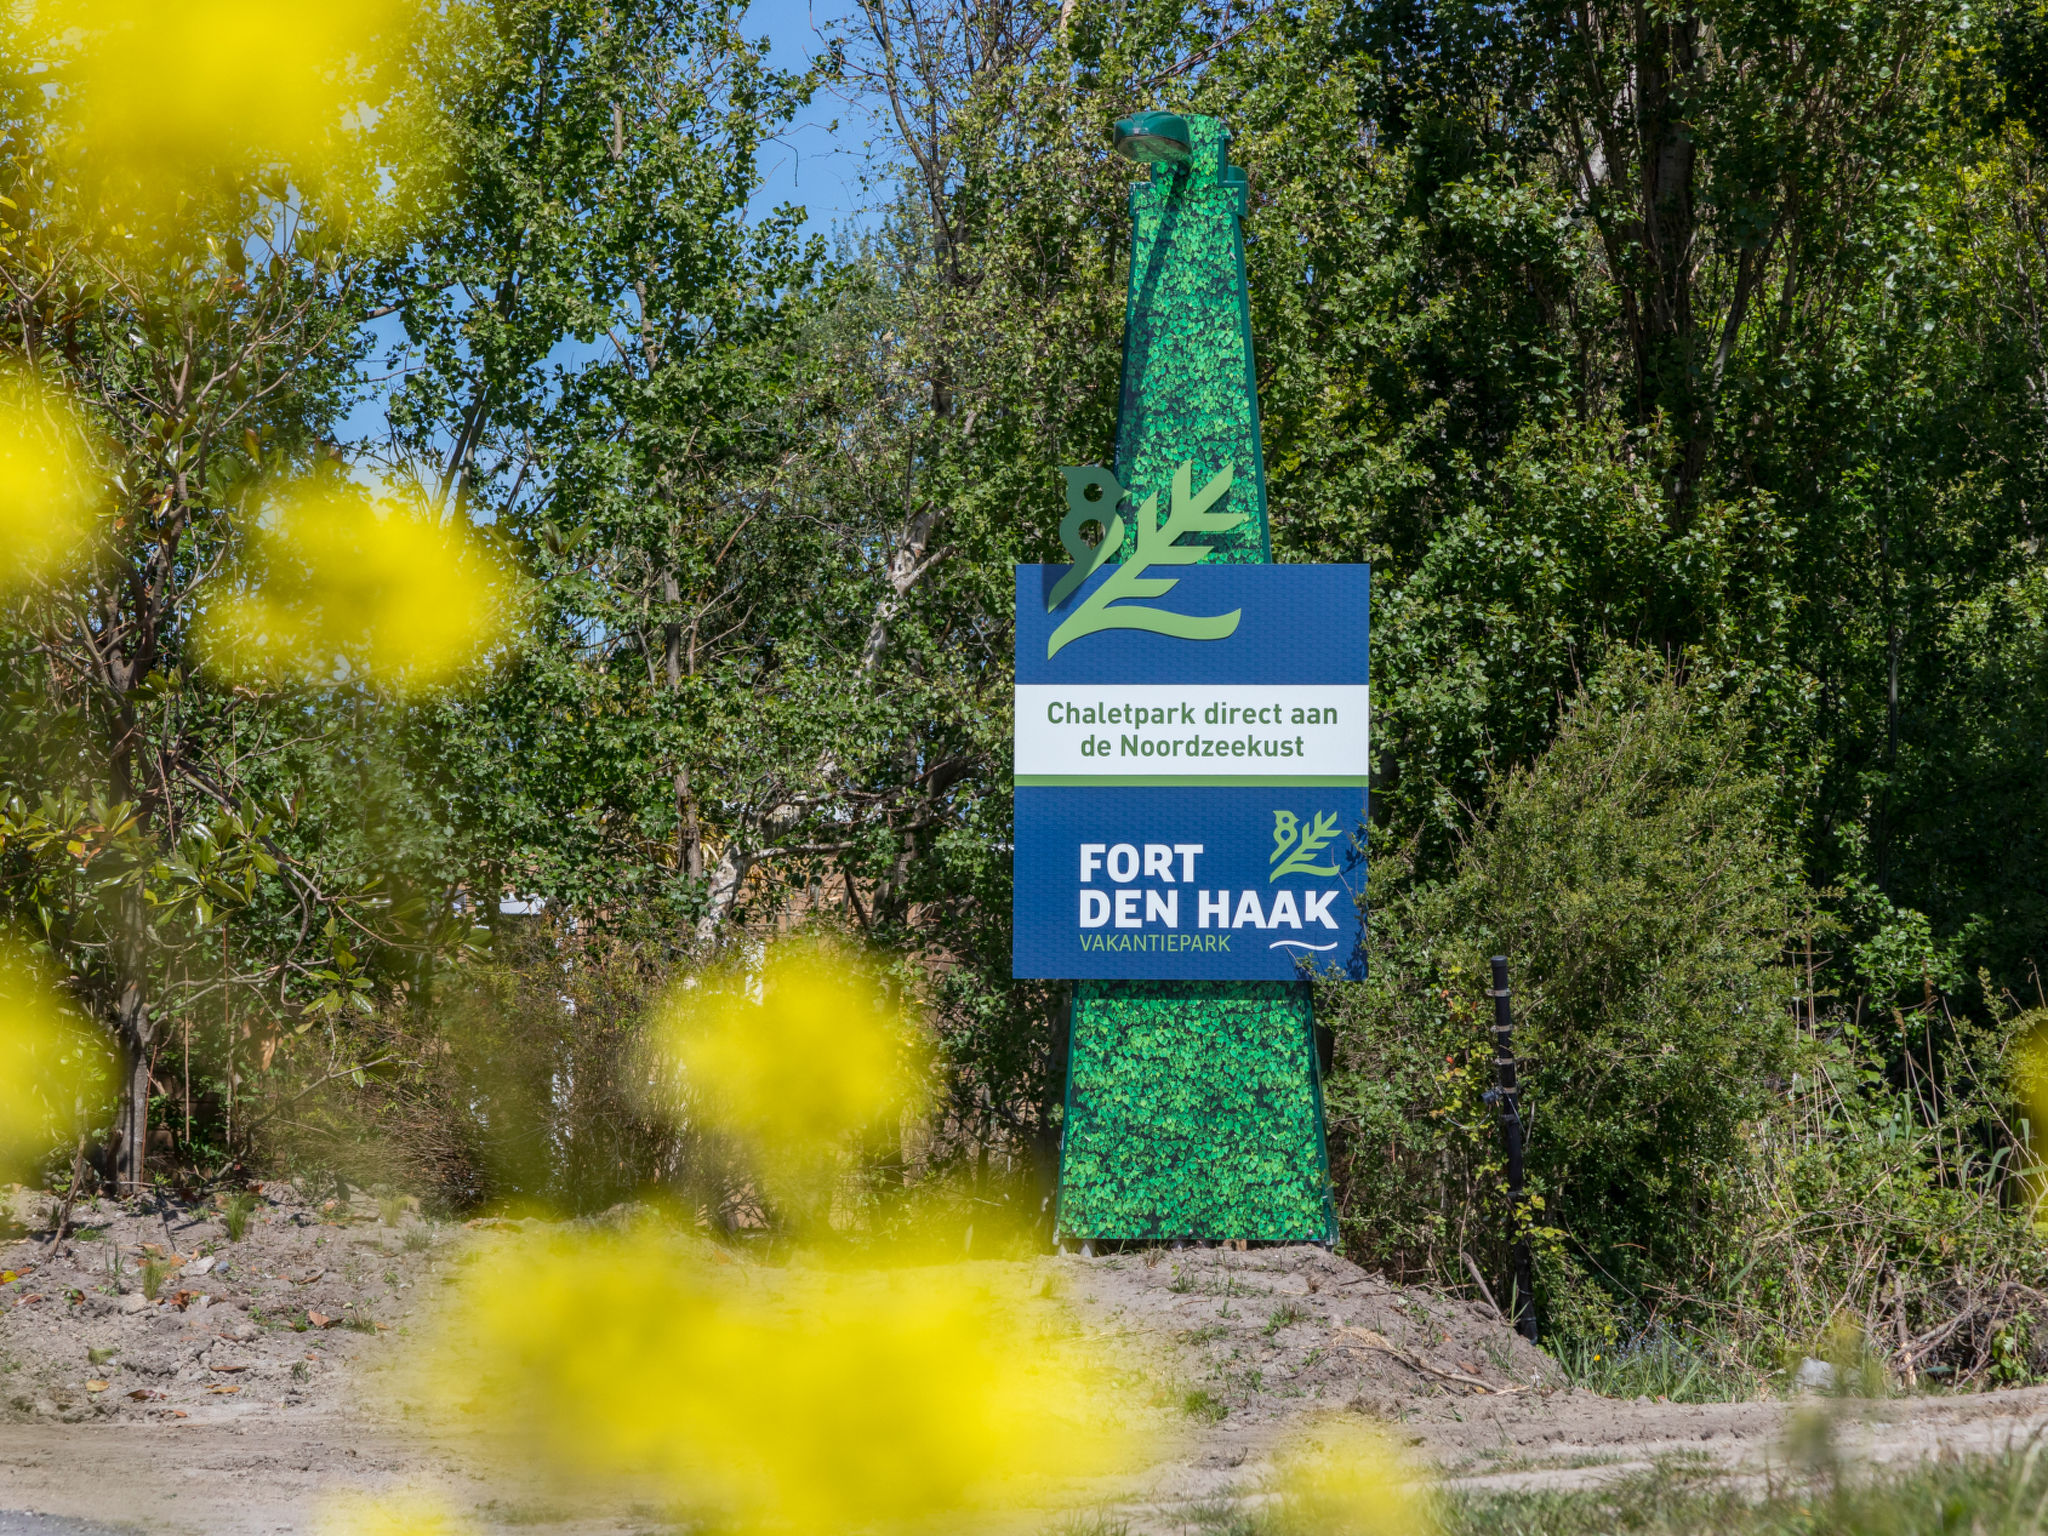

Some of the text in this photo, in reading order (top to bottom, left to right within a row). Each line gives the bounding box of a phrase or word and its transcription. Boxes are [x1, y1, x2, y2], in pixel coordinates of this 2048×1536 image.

[1047, 702, 1338, 729] Chaletpark direct aan
[1080, 734, 1304, 757] de Noordzeekust
[1080, 843, 1203, 883] FORT
[1079, 889, 1340, 929] DEN HAAK
[1079, 934, 1231, 952] VAKANTIEPARK
